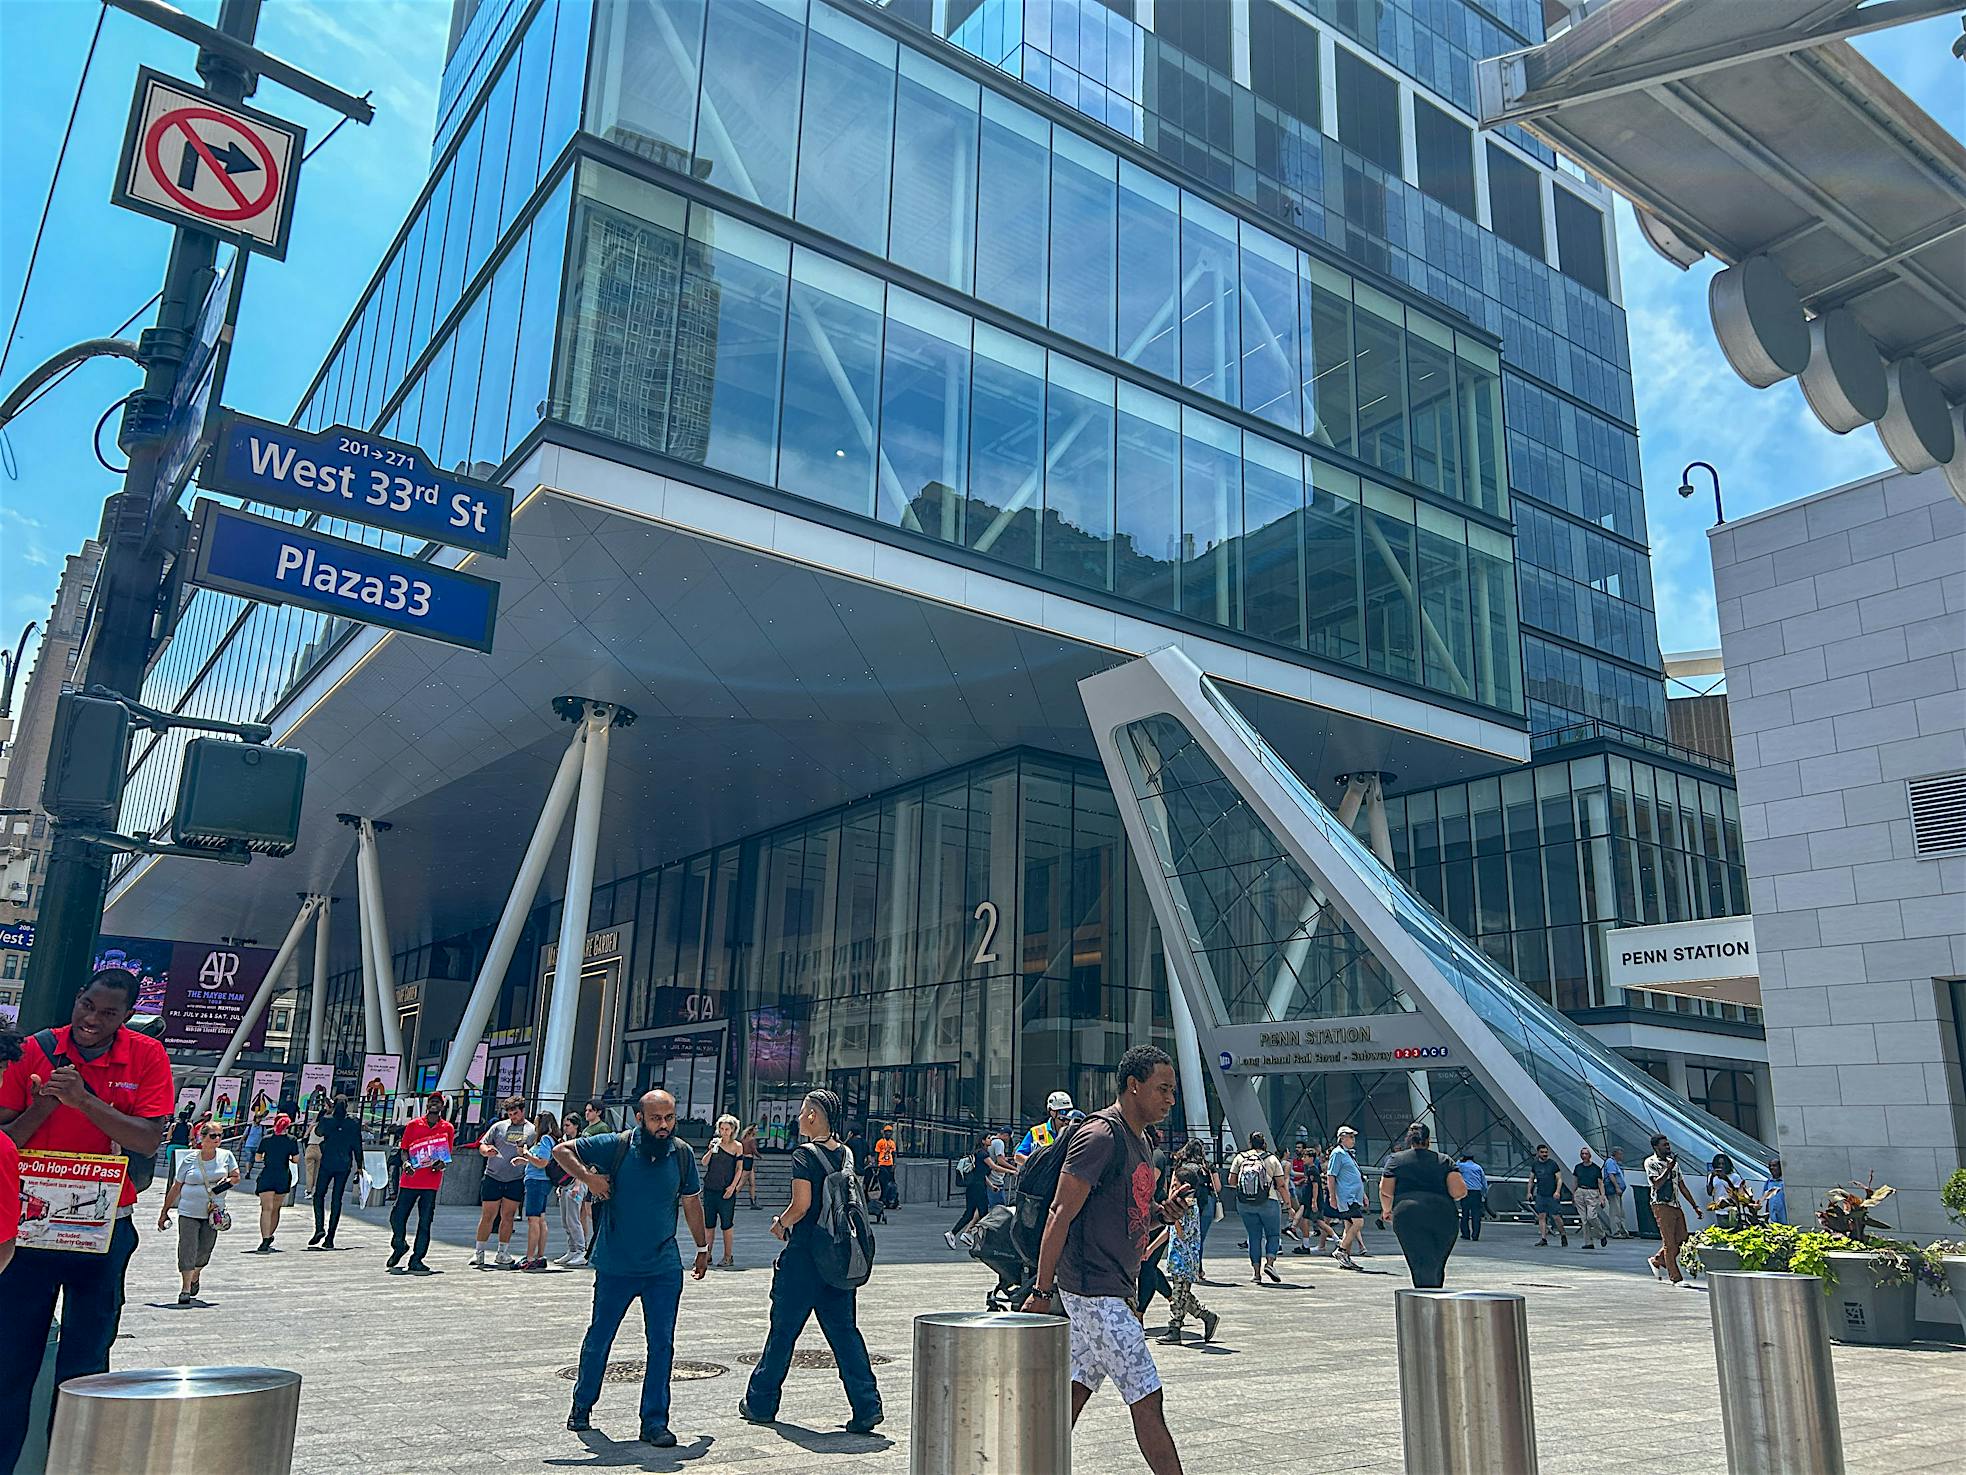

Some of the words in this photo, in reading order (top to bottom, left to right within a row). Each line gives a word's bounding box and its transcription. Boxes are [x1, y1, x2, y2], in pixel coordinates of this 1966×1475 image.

[250, 436, 355, 499] West
[366, 470, 440, 512] 33rd
[450, 493, 488, 533] St
[275, 544, 433, 617] Plaza33
[973, 901, 998, 964] 2
[1622, 949, 1667, 966] PENN
[1674, 941, 1749, 961] STATION
[199, 951, 240, 990] AJR
[187, 990, 202, 999] THE
[228, 992, 245, 1001] MAN
[1259, 1031, 1300, 1047] PENN
[1305, 1025, 1371, 1045] STATION
[1237, 1055, 1260, 1067] Long
[1263, 1052, 1291, 1064] Island
[1294, 1051, 1312, 1063] Rail
[1351, 1050, 1392, 1062] Subway
[18, 1160, 45, 1174] op-On
[47, 1161, 91, 1176] Hop-Off
[92, 1165, 121, 1178] Pass
